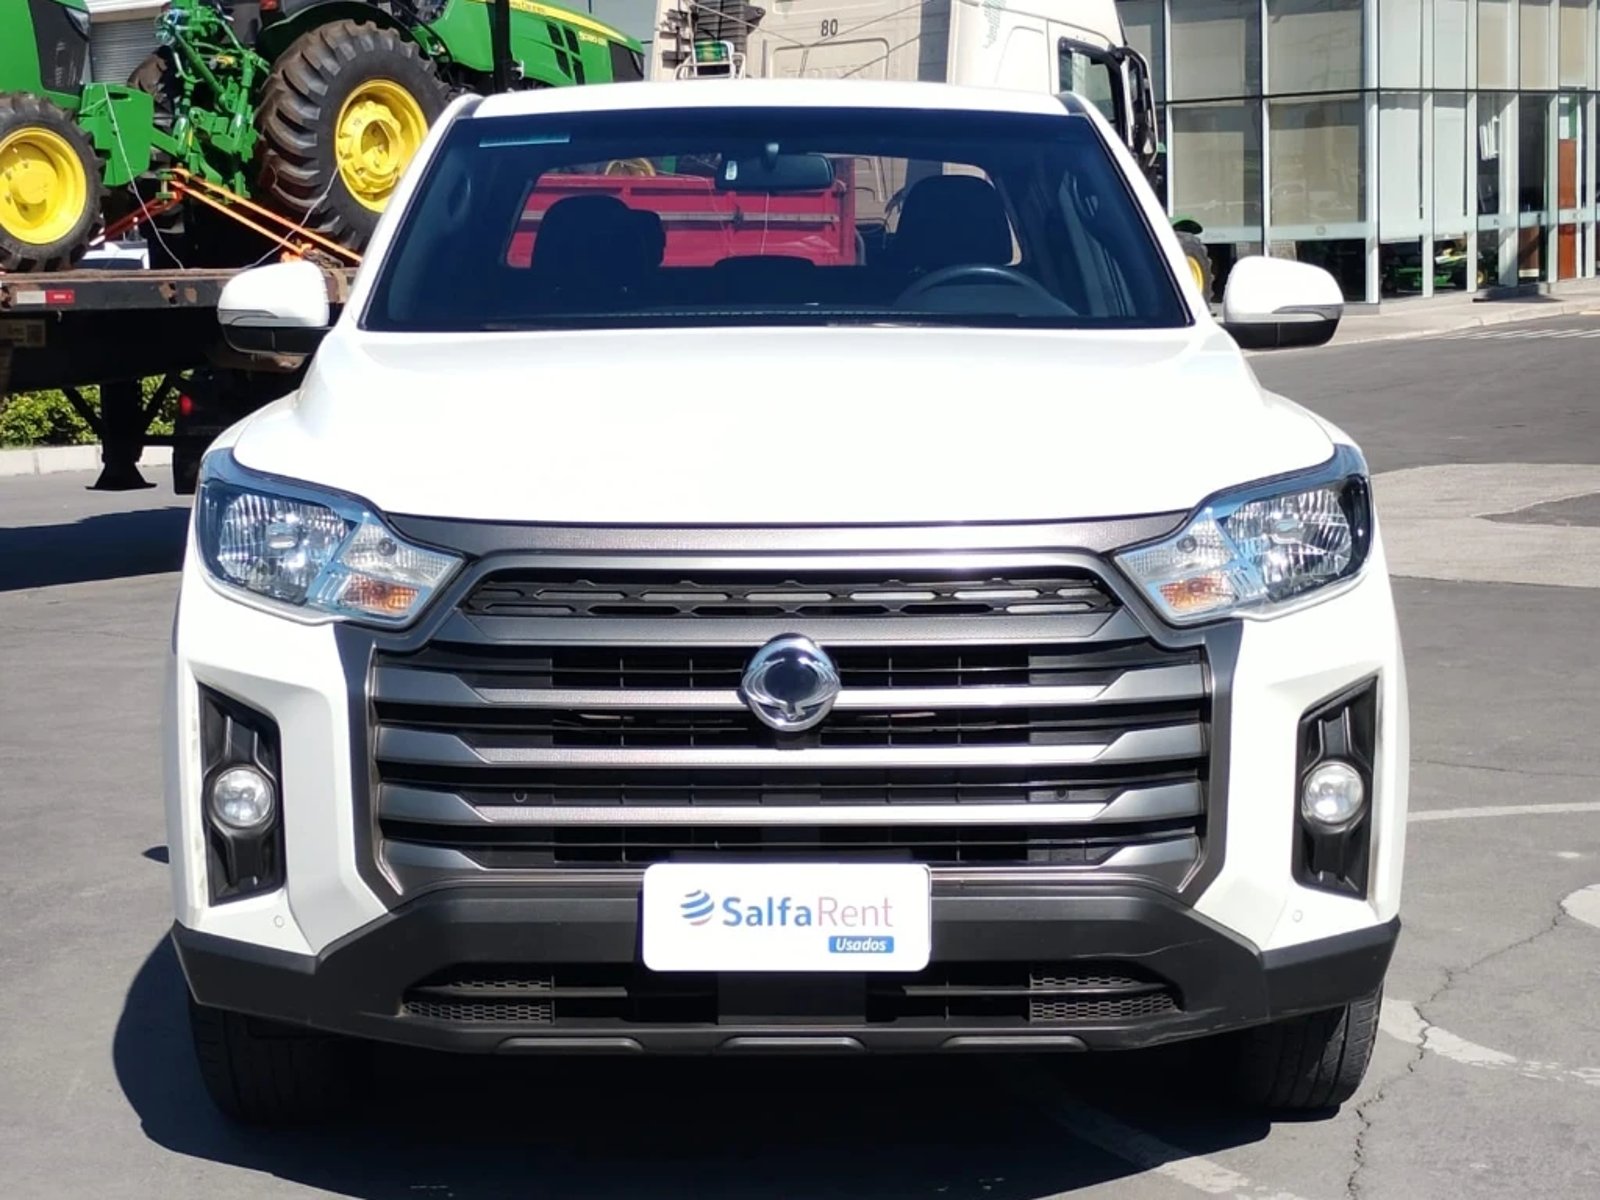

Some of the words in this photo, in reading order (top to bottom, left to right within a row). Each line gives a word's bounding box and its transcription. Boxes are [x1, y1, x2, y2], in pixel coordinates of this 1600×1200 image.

[820, 18, 838, 37] 80
[722, 896, 894, 927] SalfaRent
[835, 937, 887, 952] Usados
